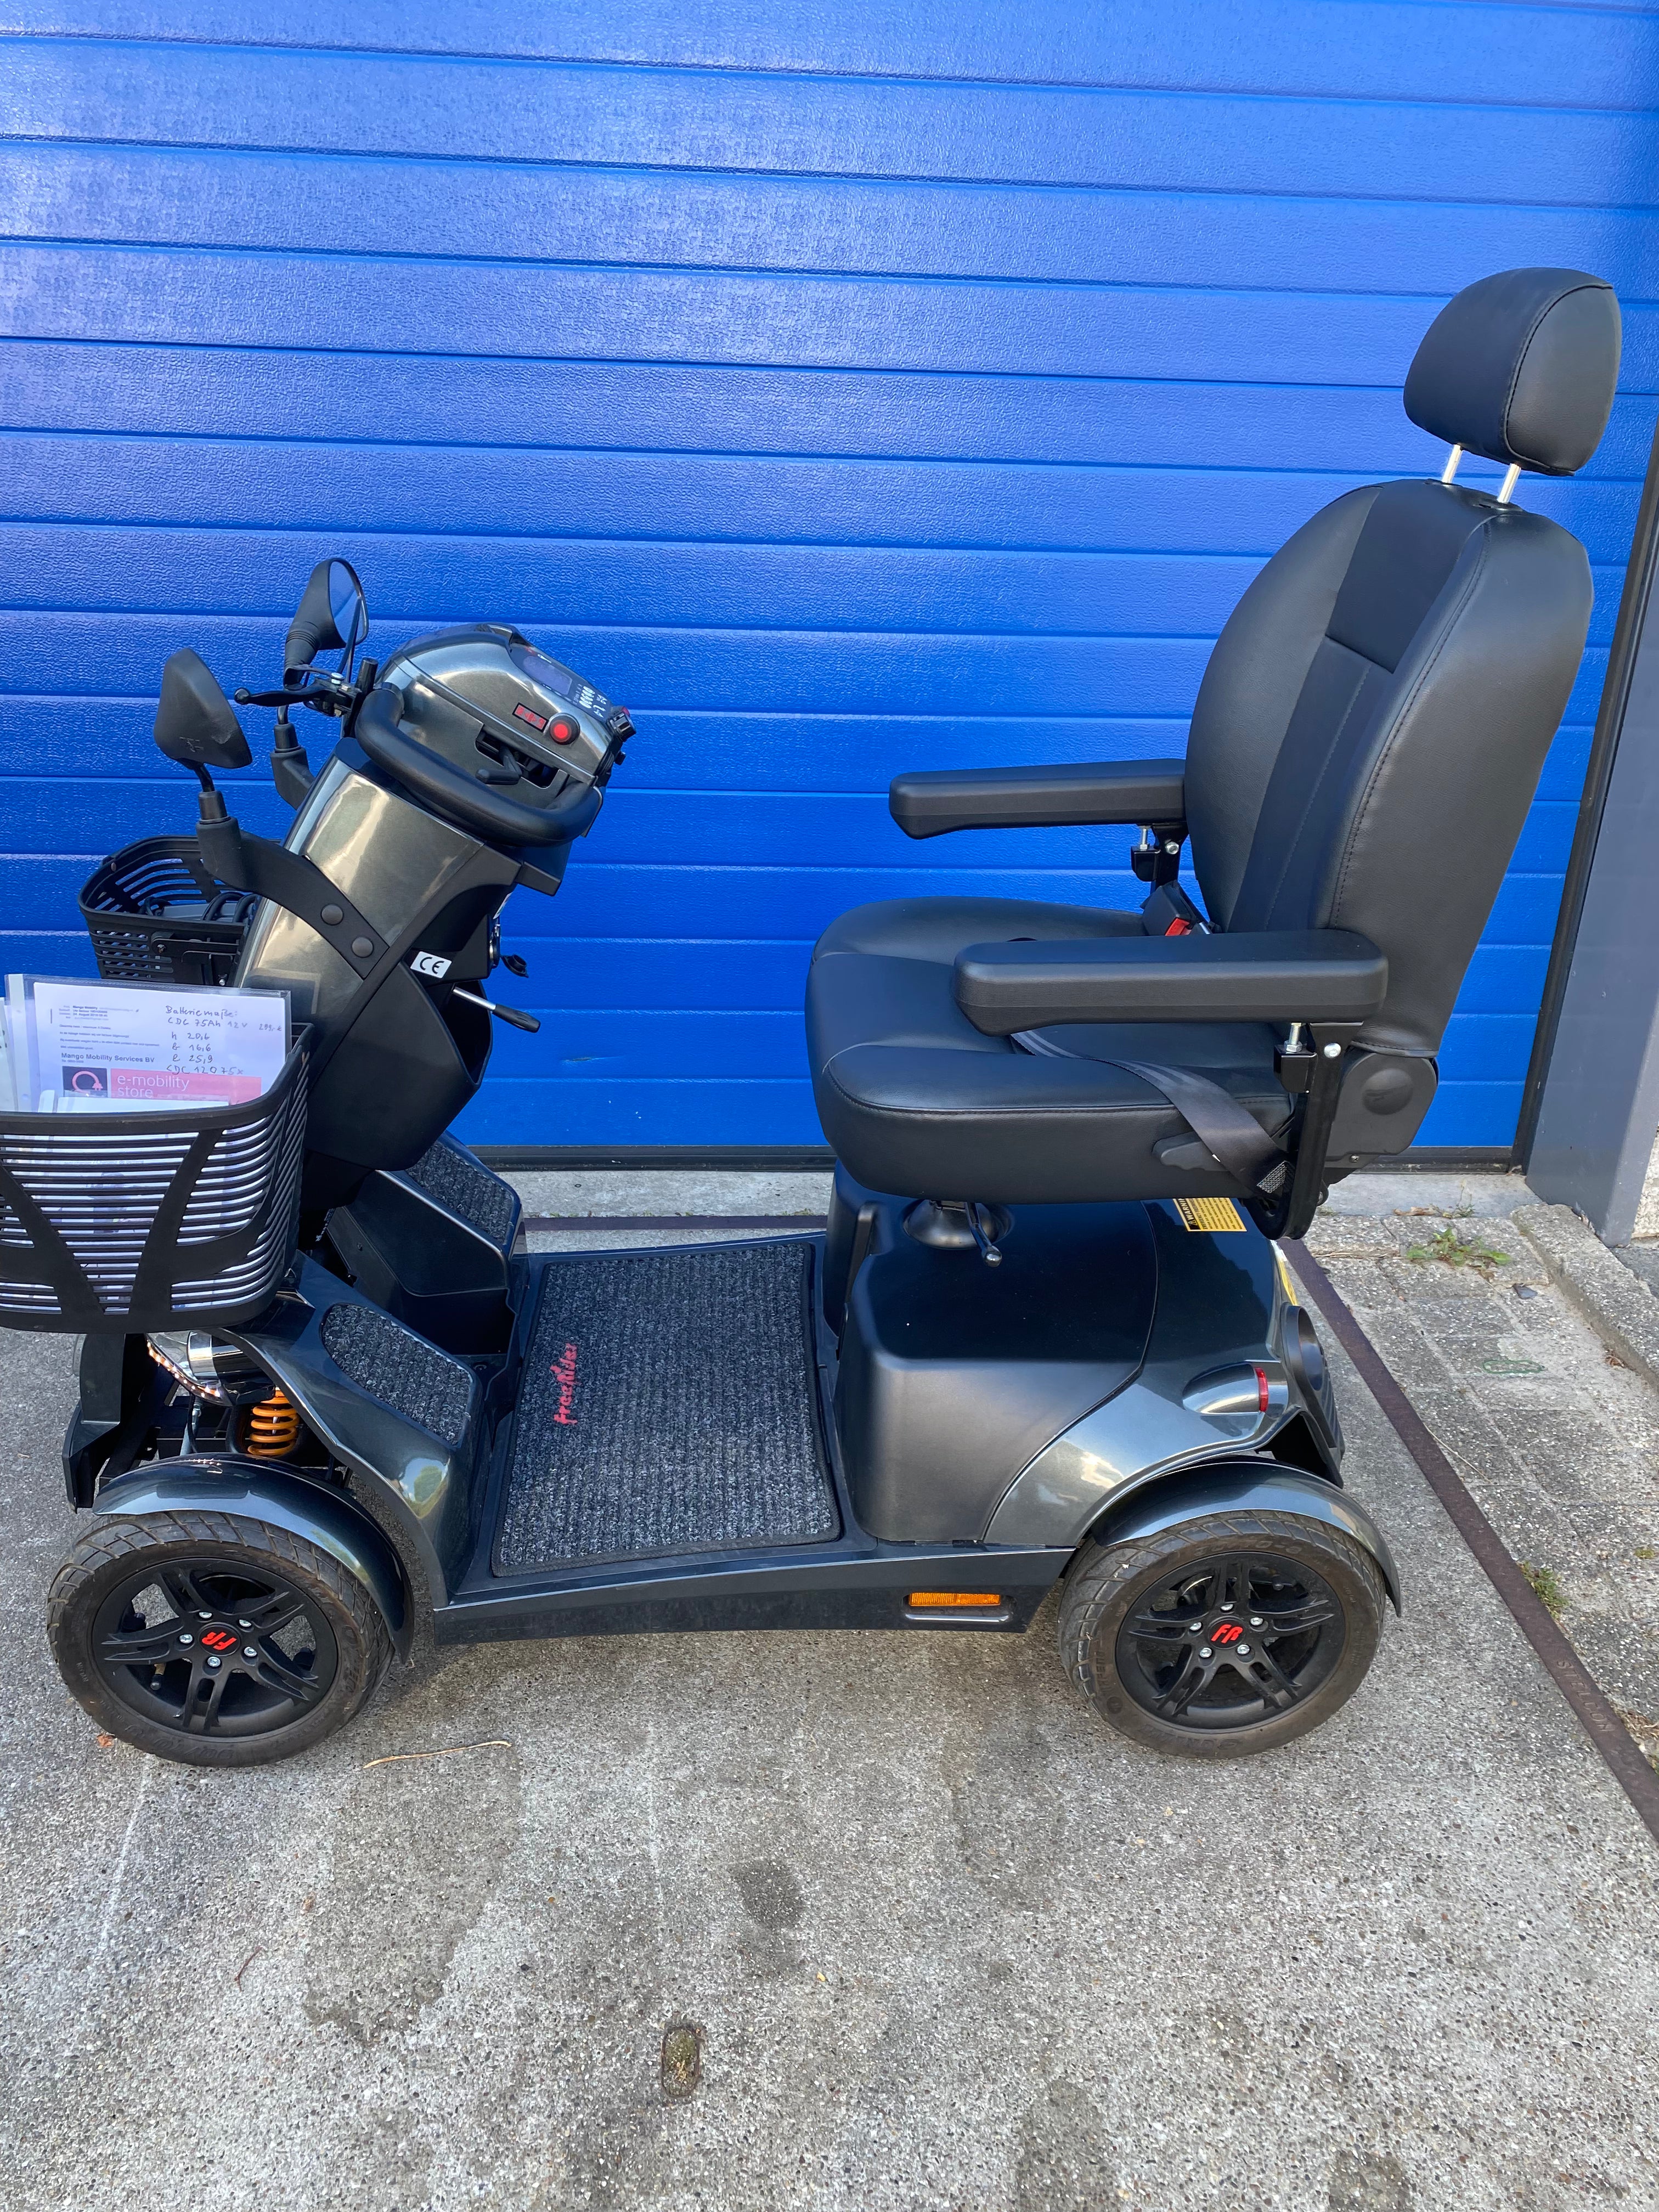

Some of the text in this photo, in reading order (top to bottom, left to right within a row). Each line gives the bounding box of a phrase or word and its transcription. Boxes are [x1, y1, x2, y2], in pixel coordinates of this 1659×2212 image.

[420, 956, 445, 974] CE
[168, 1017, 189, 1025] CDC
[171, 1031, 177, 1040] h
[189, 1043, 211, 1052] 16,6
[189, 1054, 213, 1064] 25,9
[166, 1064, 190, 1075] CDC
[117, 1075, 189, 1091] e-mobility
[117, 1086, 153, 1098] store
[1211, 1623, 1243, 1644] FR
[201, 1632, 238, 1651] FR
